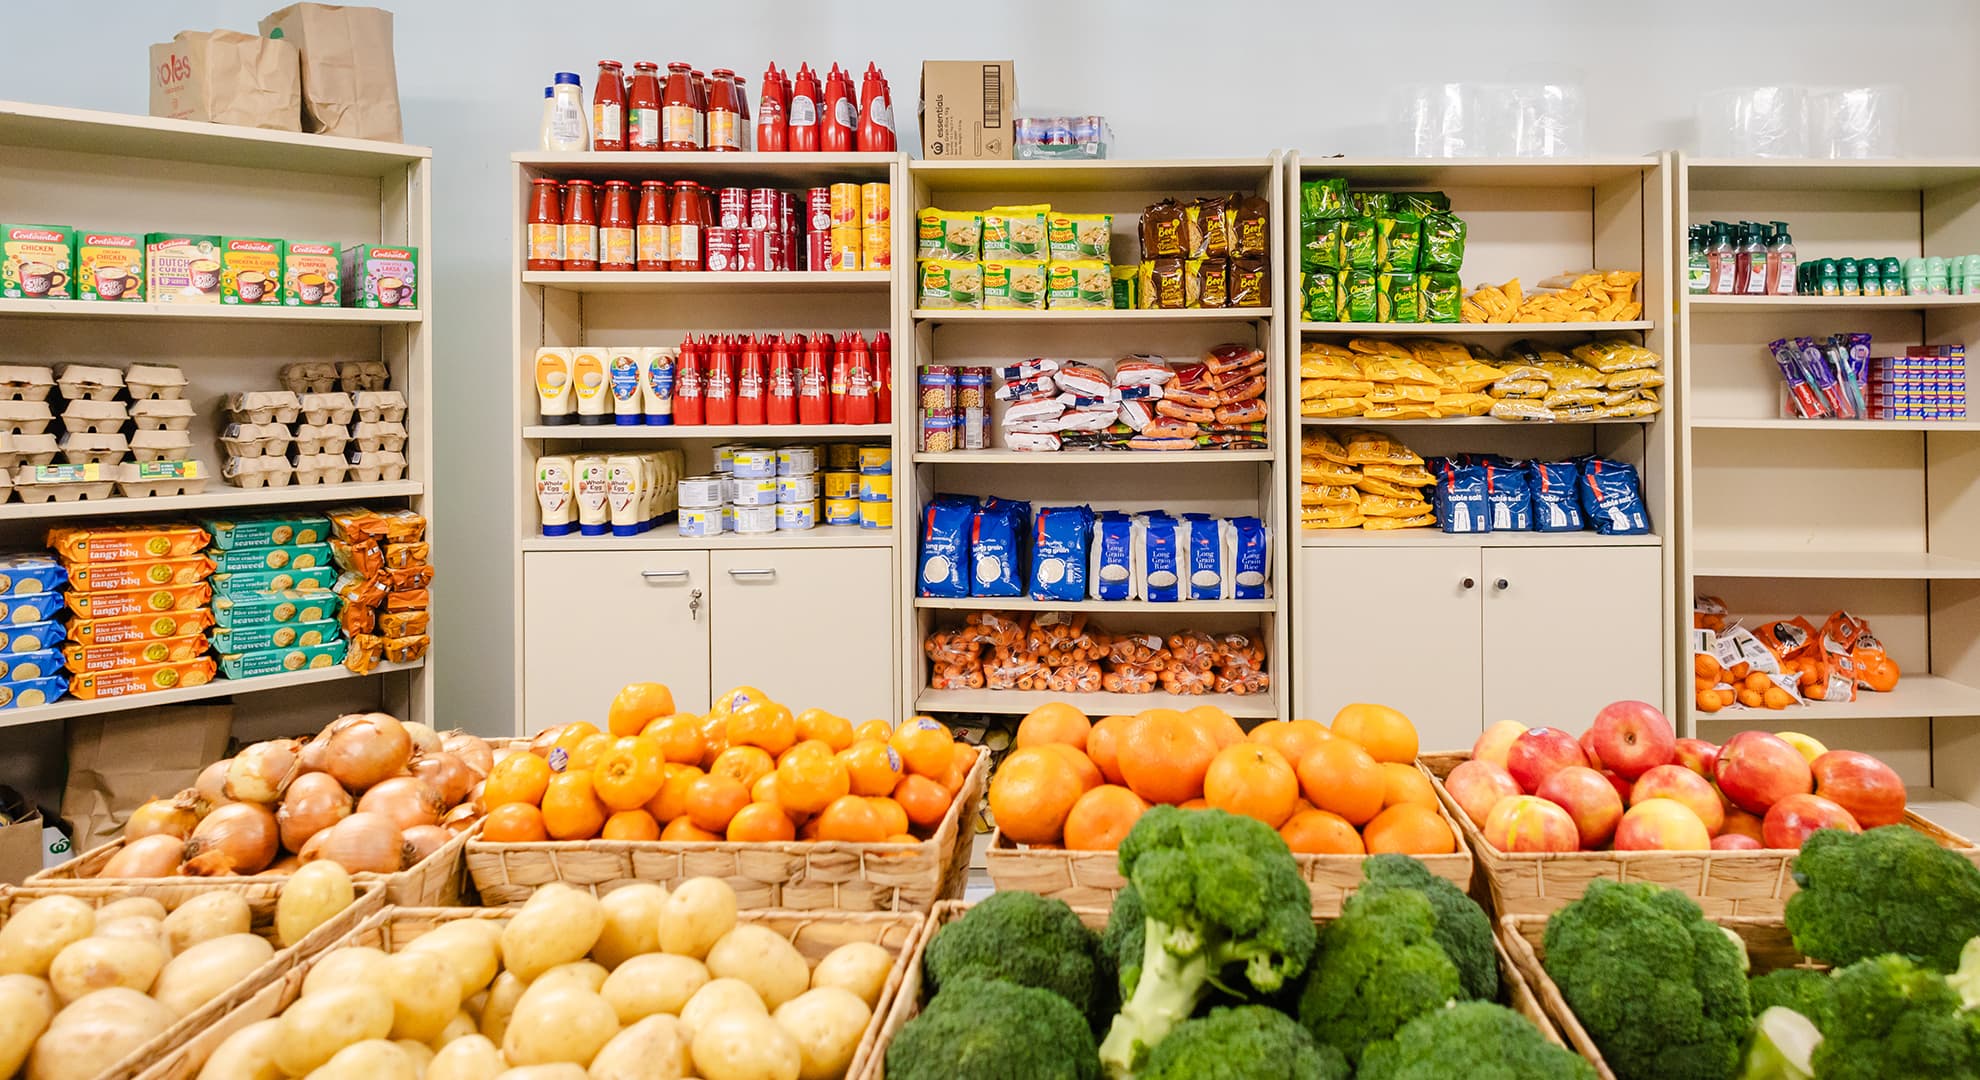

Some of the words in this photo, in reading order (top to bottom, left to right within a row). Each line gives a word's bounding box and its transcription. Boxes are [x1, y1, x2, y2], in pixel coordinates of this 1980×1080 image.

[1158, 226, 1176, 237] Beef
[1243, 224, 1262, 235] Beef
[13, 230, 60, 241] Continental
[88, 235, 132, 246] Continental
[21, 244, 54, 253] CHICKEN
[231, 241, 273, 252] Continental
[292, 245, 331, 255] Continental
[372, 250, 409, 259] Continental
[159, 257, 189, 267] DUTCH
[1206, 275, 1225, 287] Beef
[1240, 277, 1259, 288] Beef
[235, 537, 270, 547] seaweed
[1106, 543, 1124, 552] Long
[90, 551, 118, 560] tangy
[119, 549, 139, 558] bbq
[1152, 550, 1170, 558] Long
[1196, 550, 1214, 558] Long
[227, 561, 264, 570] seaweed
[91, 579, 119, 589] tangy
[121, 577, 140, 586] bbq
[92, 607, 121, 616] tangy
[122, 604, 141, 613] bbq
[232, 615, 271, 625] seaweed
[96, 634, 124, 643] tangy
[125, 631, 144, 640] bbq
[233, 640, 271, 650] seaweed
[87, 660, 116, 669] tangy
[116, 657, 136, 666] bbq
[243, 665, 281, 675] seaweed
[97, 686, 125, 696] tangy
[126, 683, 147, 692] bbq
